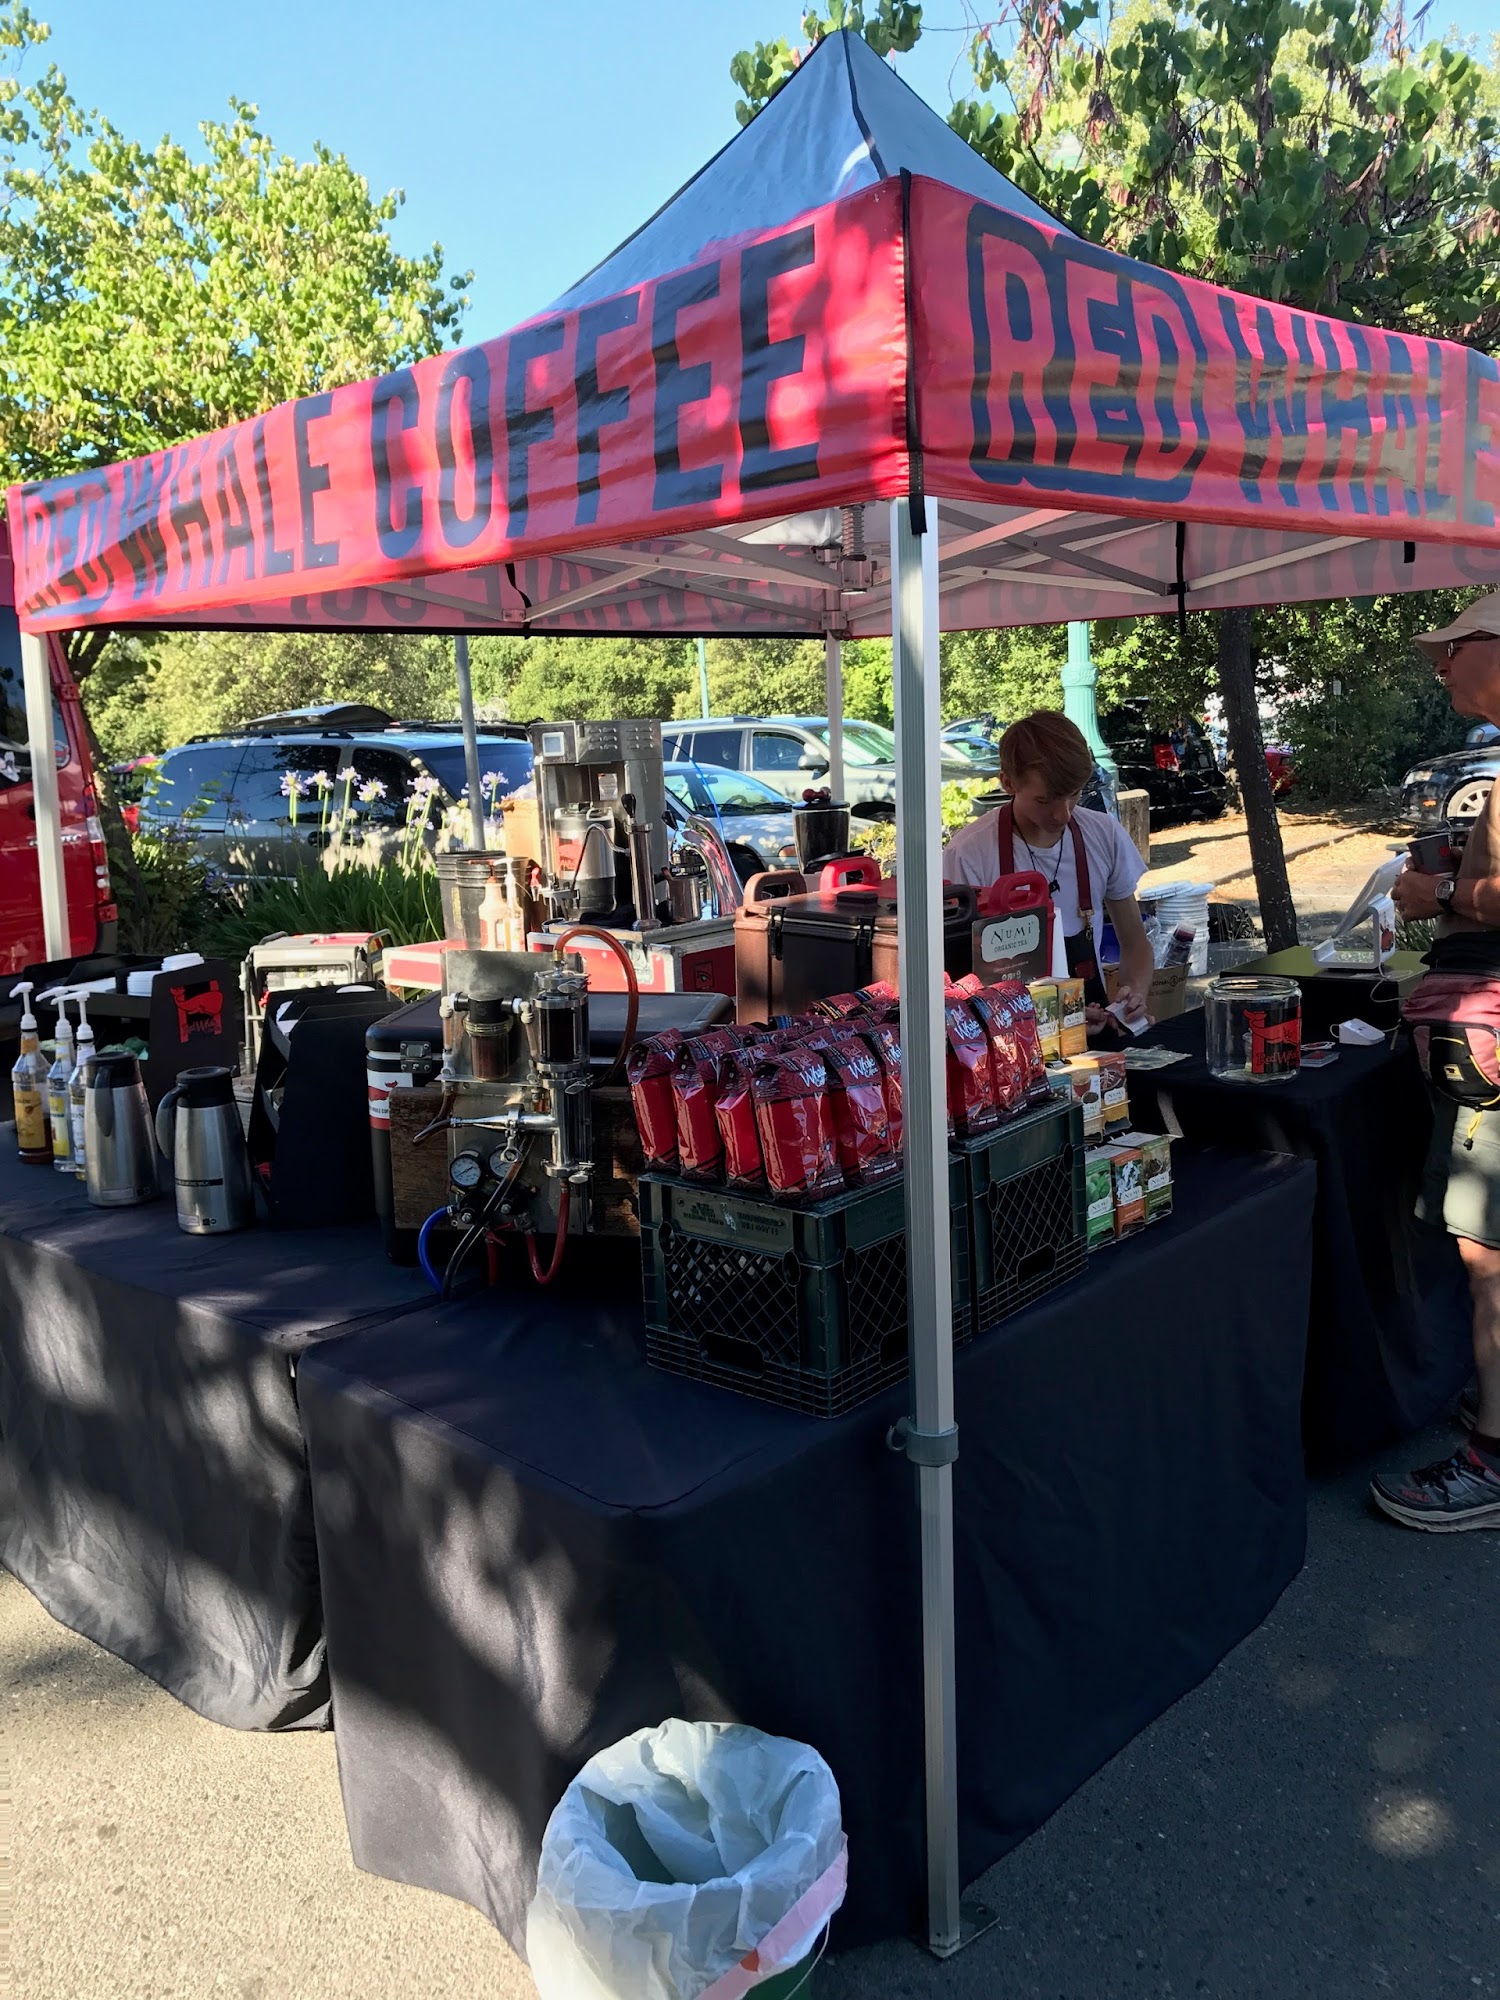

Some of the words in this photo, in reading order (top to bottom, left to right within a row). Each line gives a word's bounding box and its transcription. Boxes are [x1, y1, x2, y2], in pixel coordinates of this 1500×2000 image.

[968, 203, 1209, 503] RED
[1217, 294, 1500, 528] WHALE
[22, 472, 114, 617] RED
[118, 393, 340, 600] WHALE
[371, 224, 820, 559] COFFEE
[994, 942, 1017, 953] ORGANIC
[1018, 940, 1028, 948] TEA
[1007, 992, 1032, 1014] Whale
[954, 1018, 980, 1041] Whale
[799, 1062, 828, 1088] Whale
[847, 1054, 877, 1080] Whale
